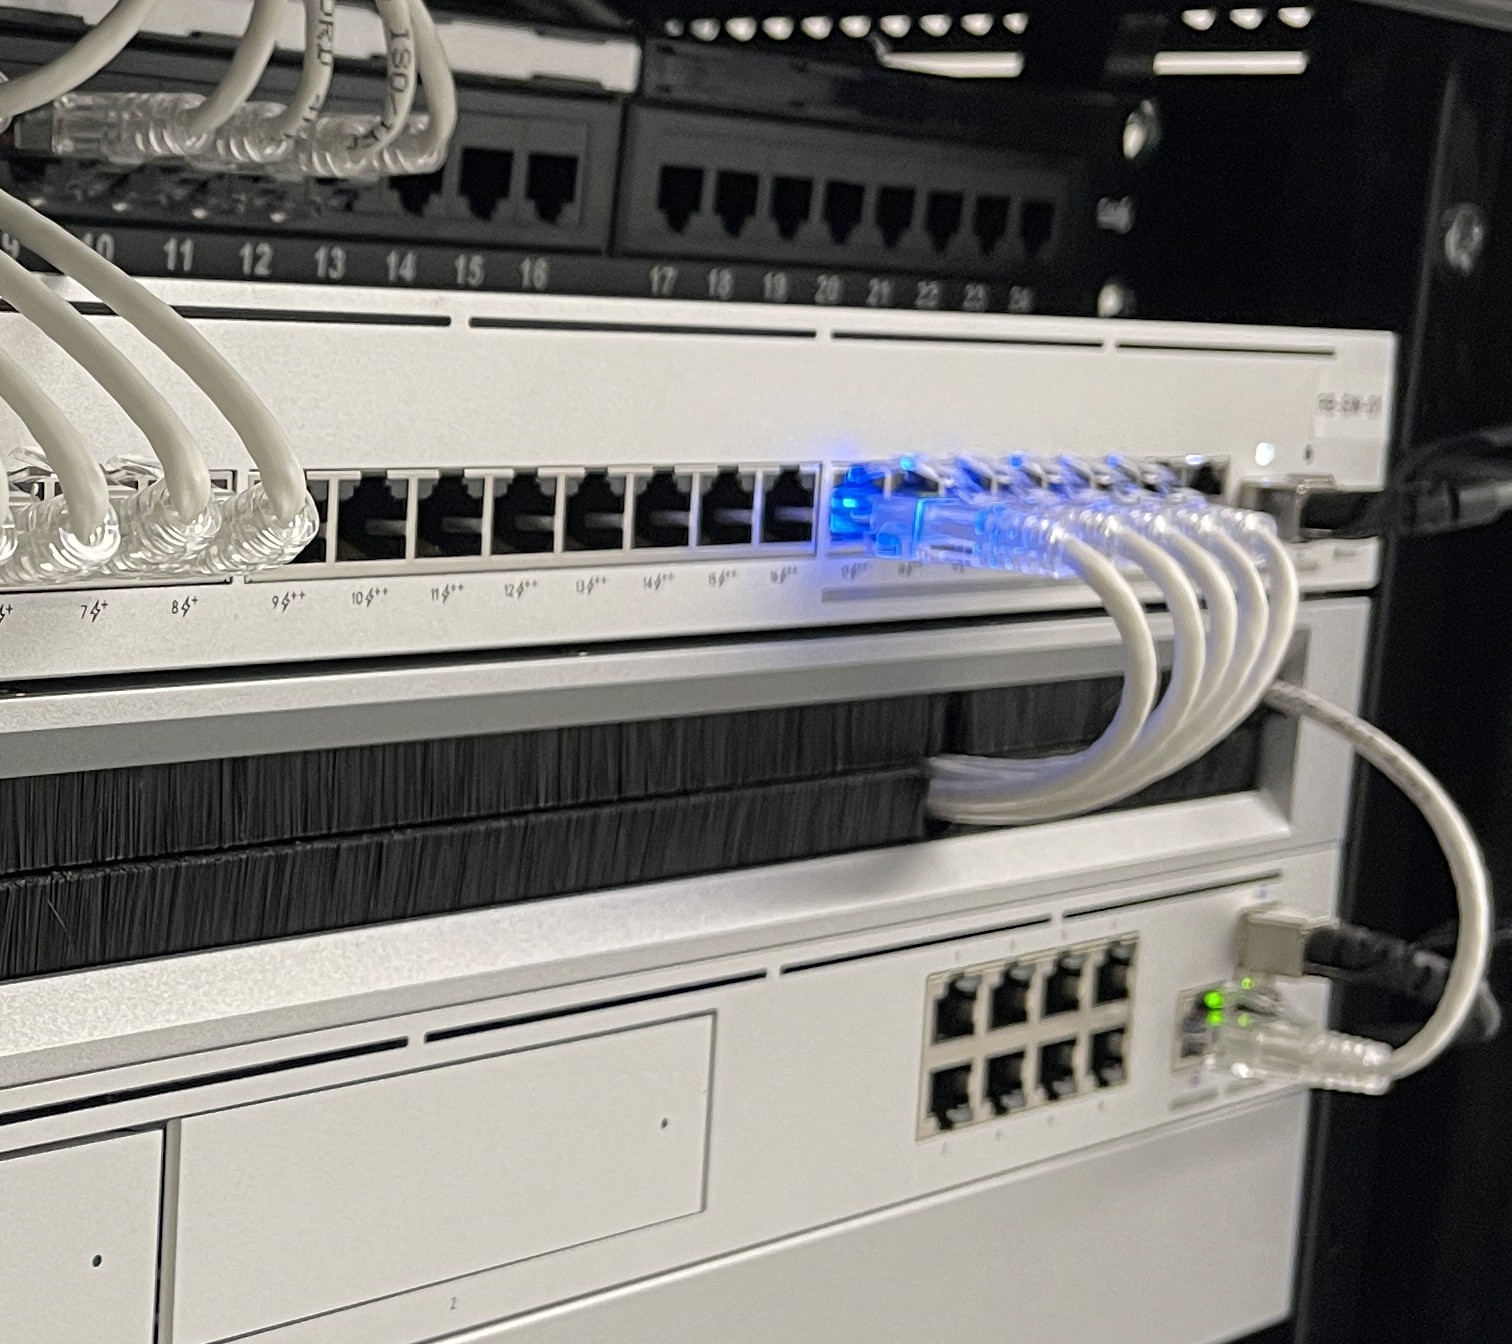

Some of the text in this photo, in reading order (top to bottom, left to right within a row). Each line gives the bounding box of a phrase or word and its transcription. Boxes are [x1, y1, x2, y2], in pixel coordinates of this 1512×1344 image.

[164, 237, 194, 272] 11
[240, 242, 273, 275] 12
[315, 246, 346, 279] 13
[388, 250, 417, 282] 14
[454, 254, 485, 286] 15
[520, 257, 549, 290] 16
[651, 265, 678, 296] 17
